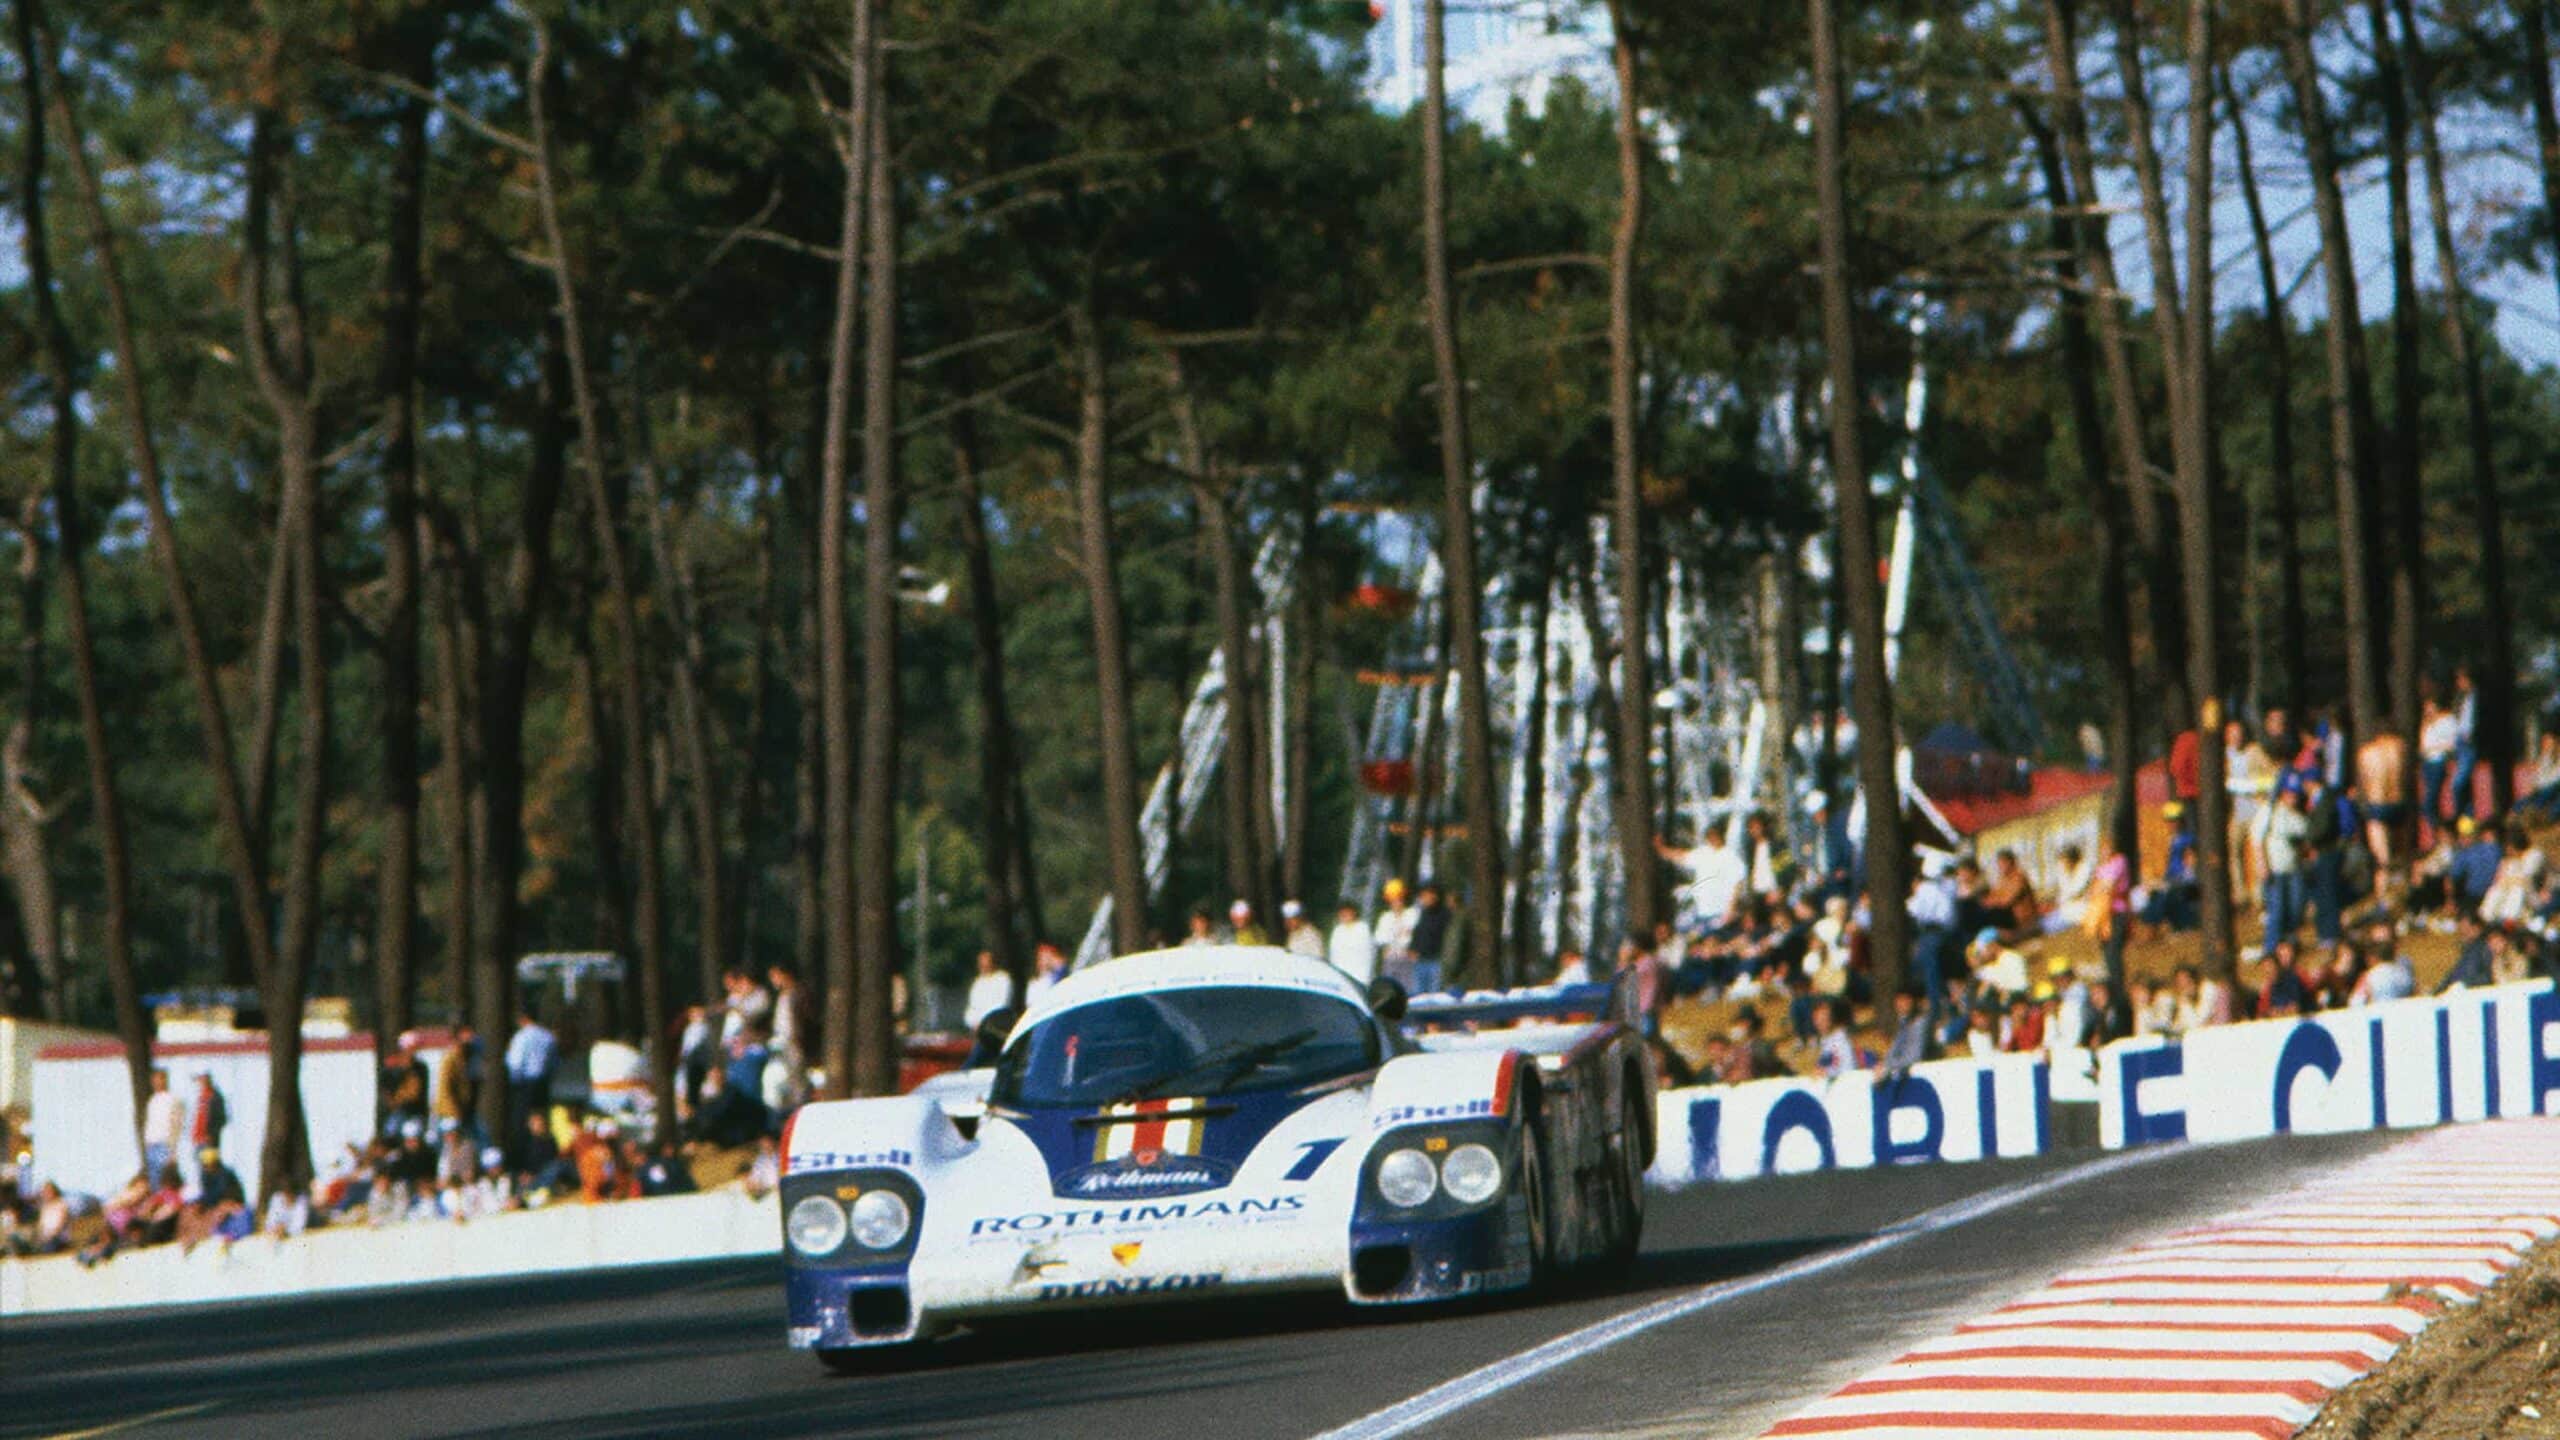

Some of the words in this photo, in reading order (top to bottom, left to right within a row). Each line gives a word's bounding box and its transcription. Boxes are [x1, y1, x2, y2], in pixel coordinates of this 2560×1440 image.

[1079, 1160, 1211, 1192] Rothmans
[1284, 1137, 1350, 1180] 1
[971, 1194, 1306, 1236] ROTHMANS
[1038, 1273, 1223, 1301] DUNLOP
